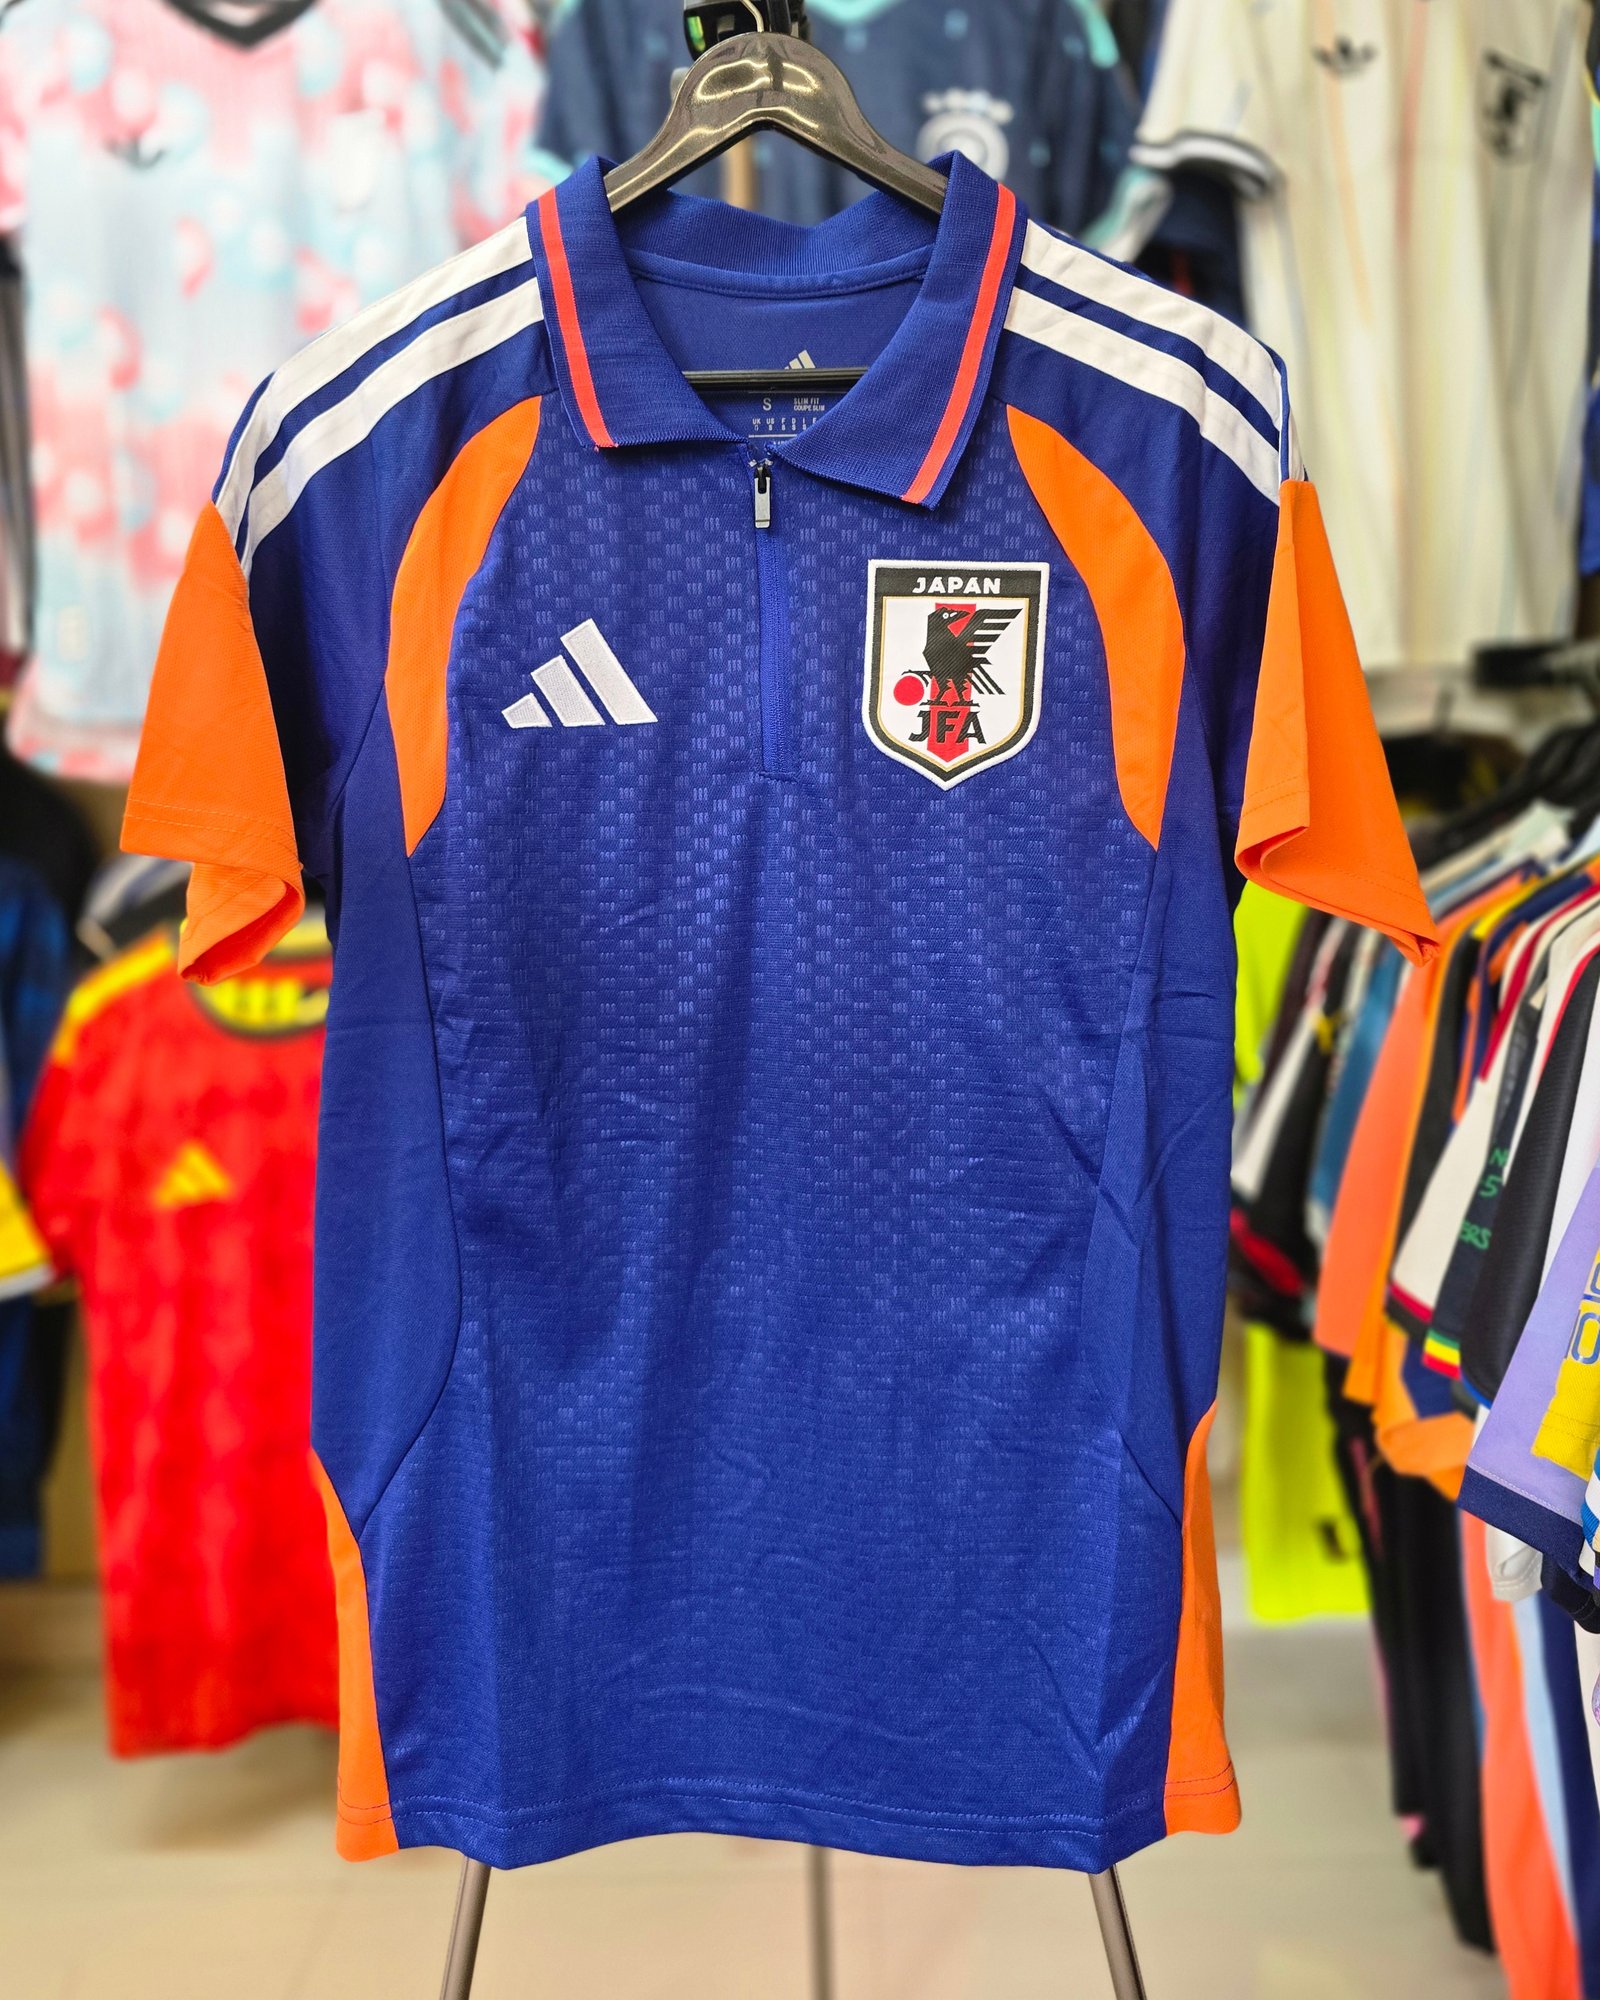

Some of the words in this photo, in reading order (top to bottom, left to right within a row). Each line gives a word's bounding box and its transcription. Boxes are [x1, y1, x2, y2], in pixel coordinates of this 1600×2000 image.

[763, 398, 772, 411] S
[793, 397, 809, 405] SLIM
[810, 397, 820, 405] FIT
[766, 417, 775, 425] US
[781, 417, 786, 425] F
[912, 576, 1001, 595] JAPAN
[908, 710, 987, 744] JFA
